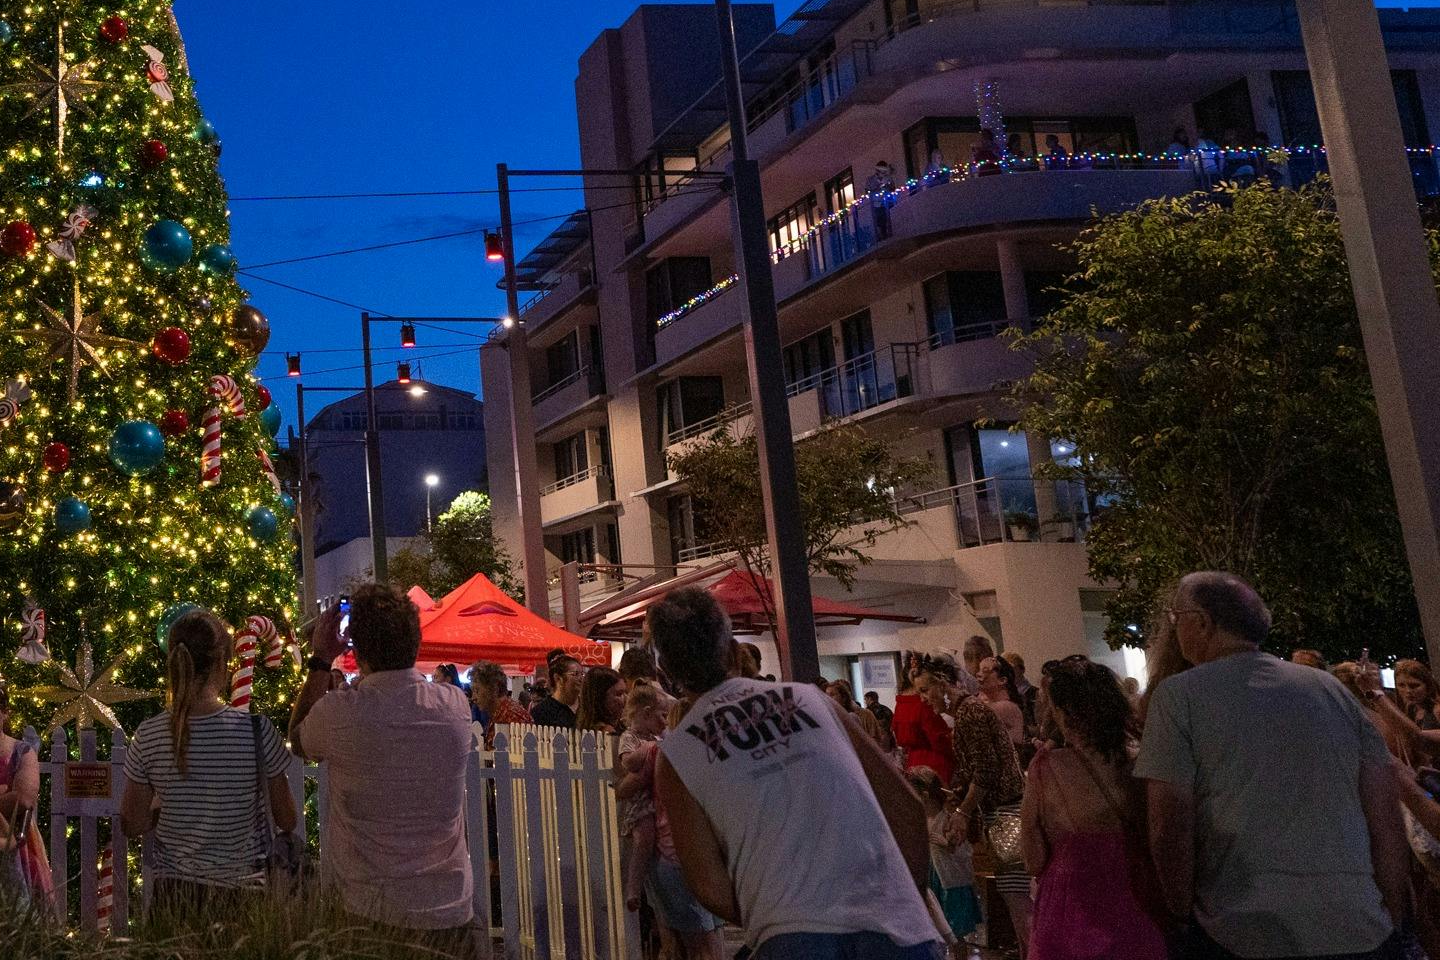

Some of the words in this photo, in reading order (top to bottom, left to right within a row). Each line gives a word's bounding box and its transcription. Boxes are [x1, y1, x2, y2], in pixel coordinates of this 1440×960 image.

[446, 624, 545, 642] HASTINGS
[711, 686, 755, 707] NEW
[685, 686, 820, 762] YORK
[750, 737, 791, 761] CITY
[70, 767, 107, 777] WARNING
